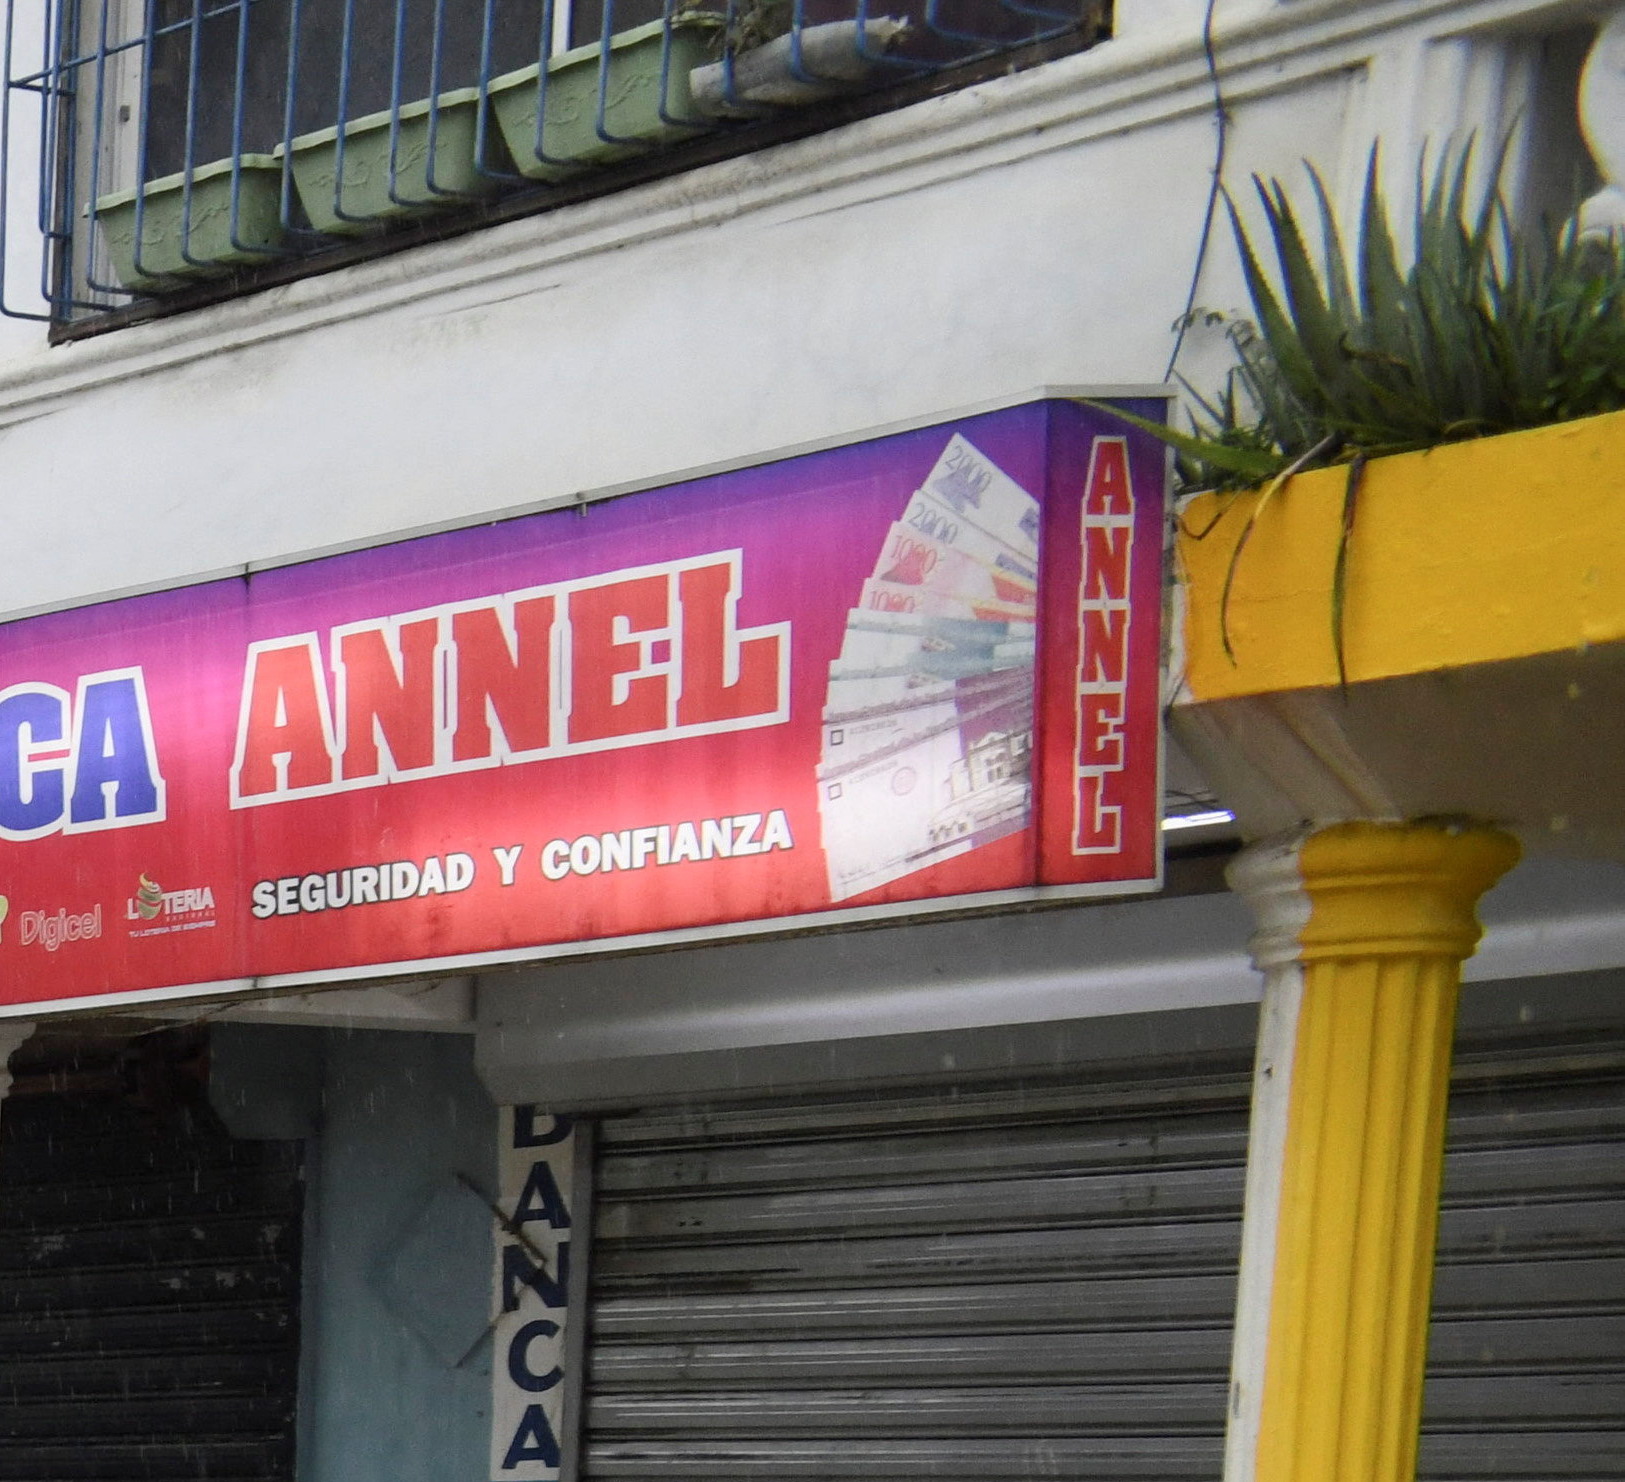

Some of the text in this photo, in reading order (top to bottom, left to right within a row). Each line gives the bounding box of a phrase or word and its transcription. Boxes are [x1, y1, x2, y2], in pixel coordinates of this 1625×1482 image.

[230, 548, 792, 810] ANNEL
[1072, 436, 1136, 855] ANNEL
[21, 903, 102, 951] Digicel
[251, 809, 793, 919] SEGURIDAD Y CONFIANZA
